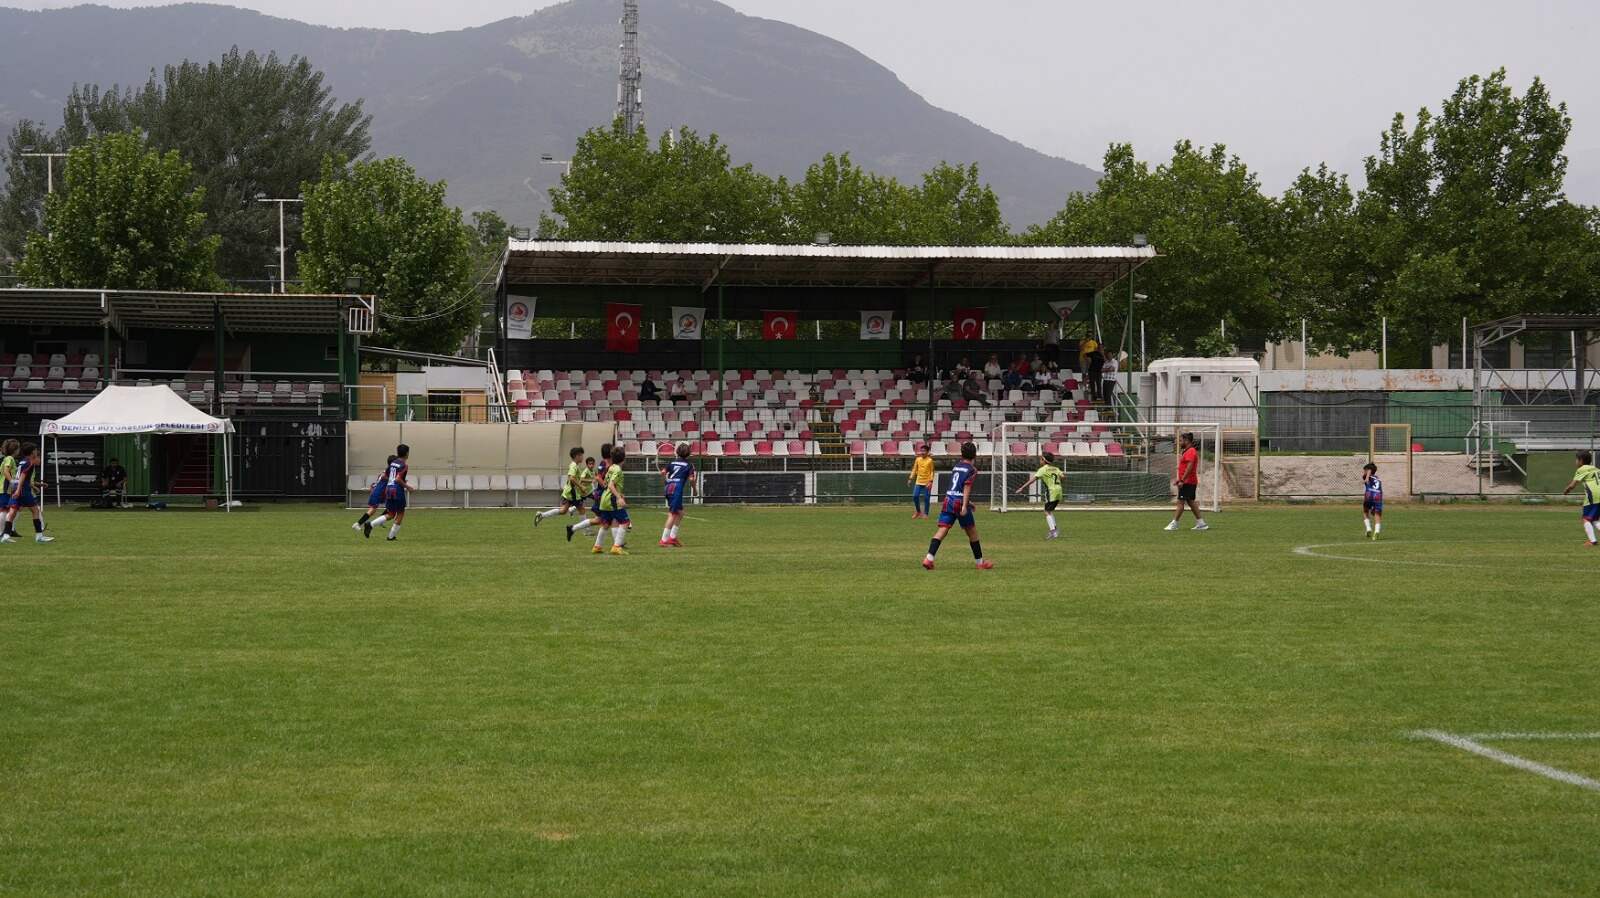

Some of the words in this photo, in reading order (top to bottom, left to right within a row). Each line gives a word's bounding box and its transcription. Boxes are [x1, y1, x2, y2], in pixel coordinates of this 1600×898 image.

[670, 465, 681, 479] 7
[1051, 472, 1060, 485] 2
[951, 471, 960, 491] 9
[1372, 479, 1380, 490] 3
